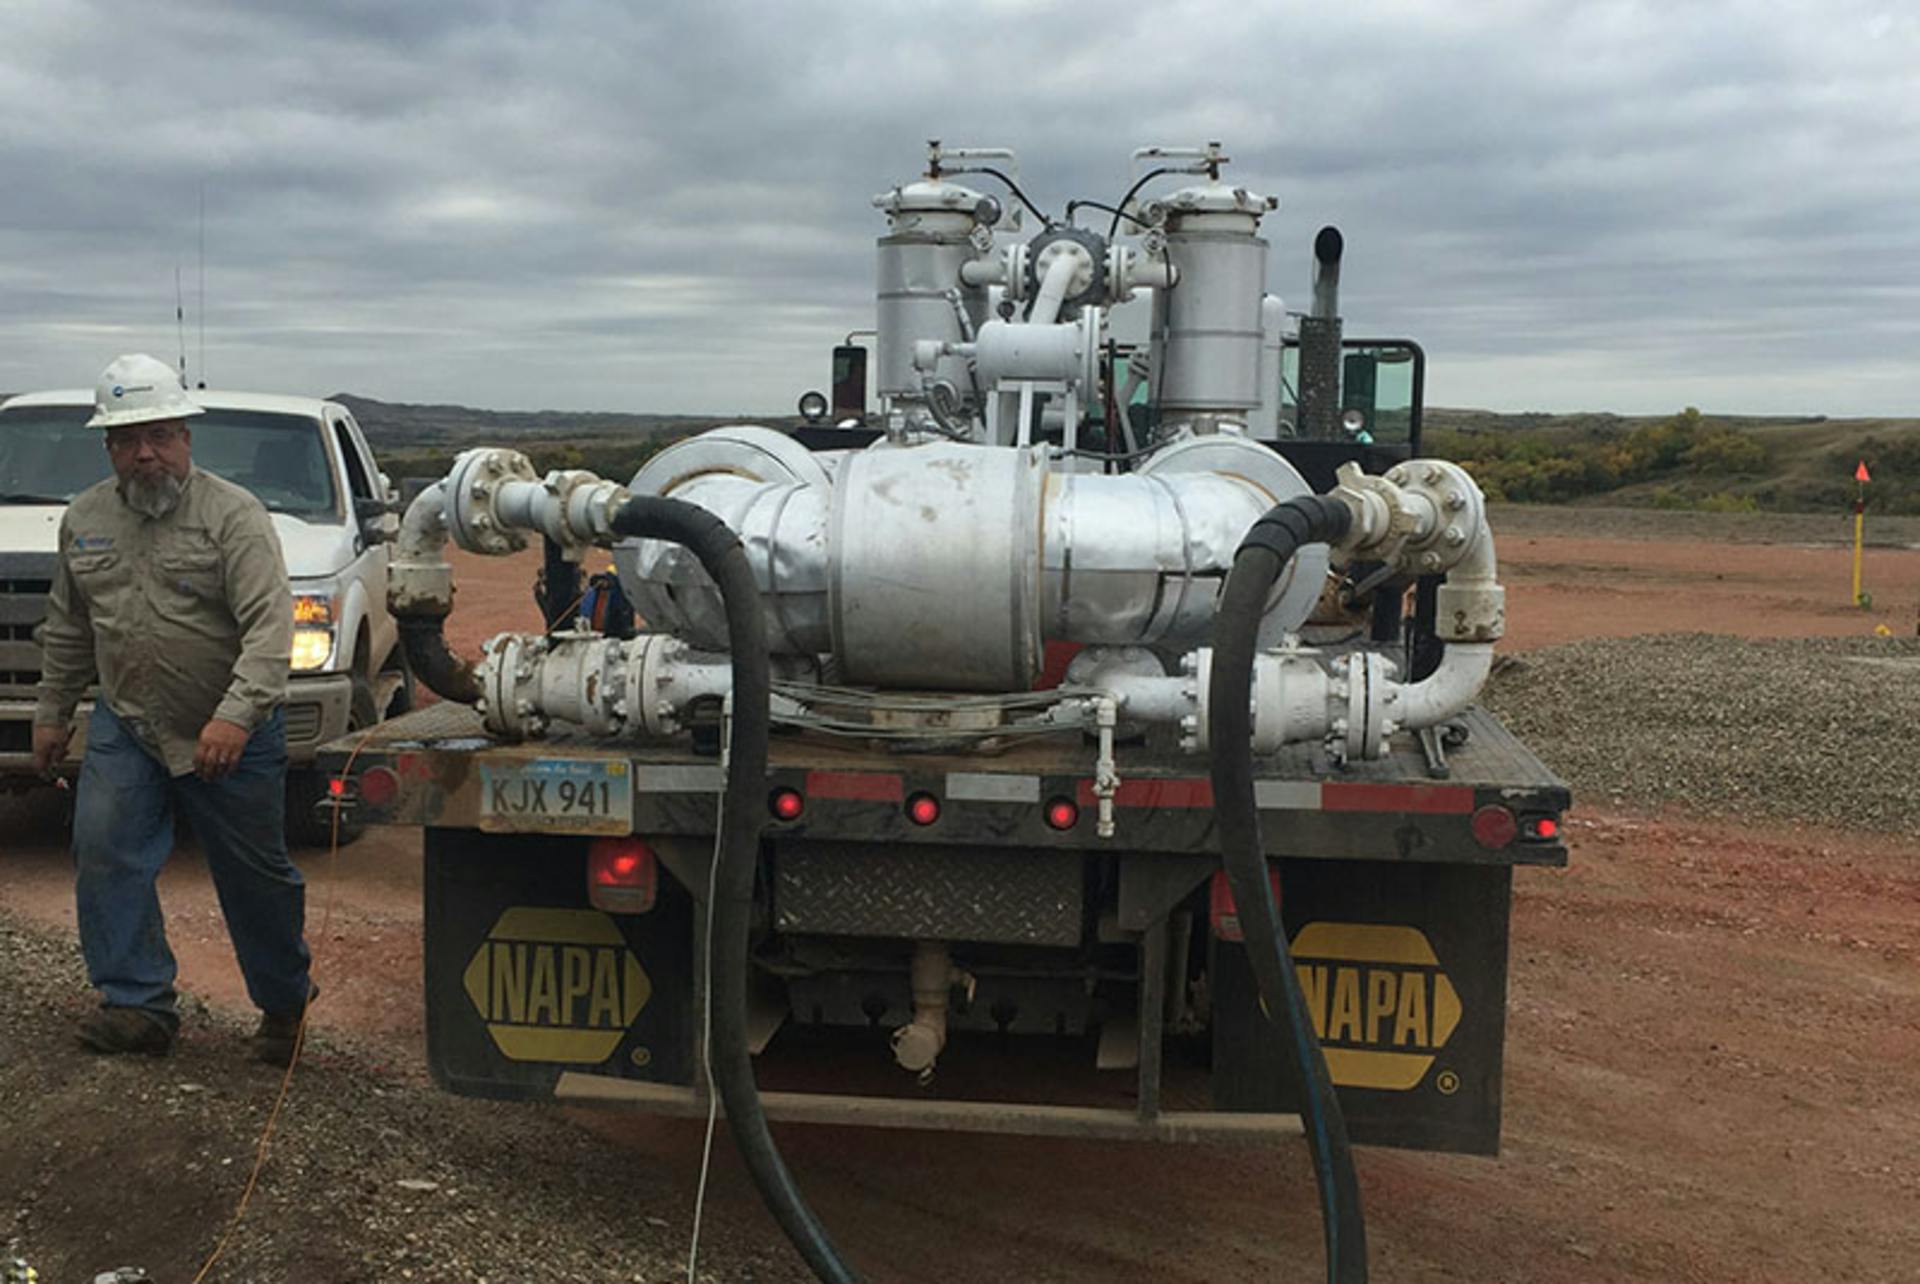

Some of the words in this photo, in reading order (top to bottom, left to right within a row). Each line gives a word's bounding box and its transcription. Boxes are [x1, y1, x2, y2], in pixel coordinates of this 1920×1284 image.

[491, 778, 547, 813] KJX
[558, 779, 610, 814] 941
[492, 942, 623, 1027] NAPA
